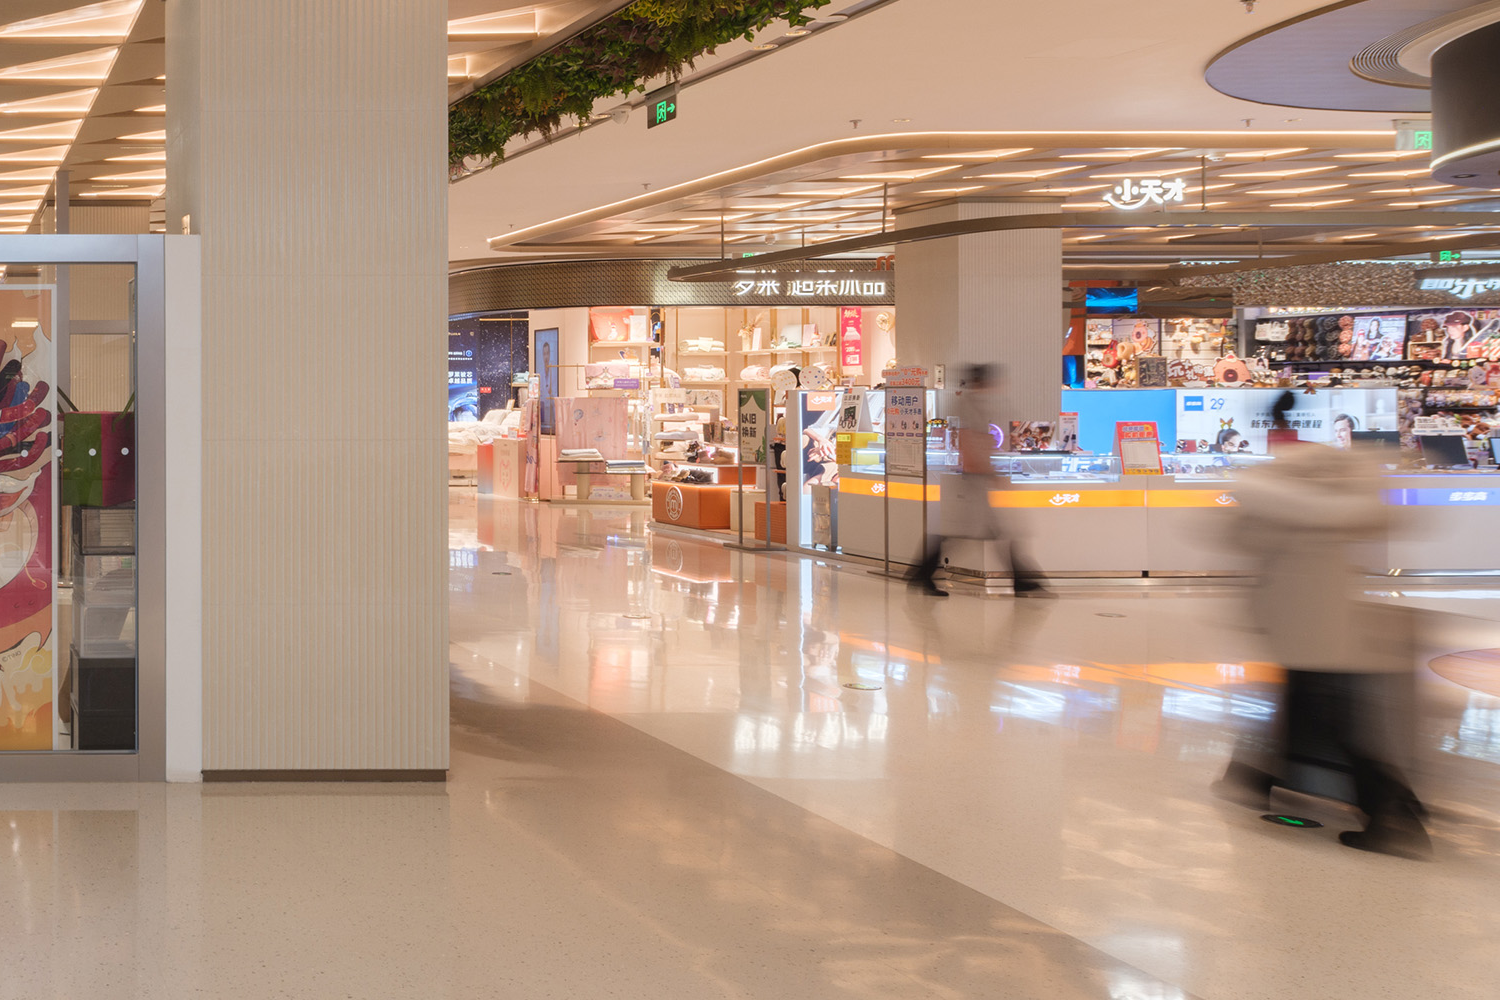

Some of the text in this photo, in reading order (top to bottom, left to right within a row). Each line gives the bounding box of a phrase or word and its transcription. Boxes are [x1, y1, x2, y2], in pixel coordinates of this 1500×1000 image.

[1102, 178, 1187, 210] 小天才
[891, 396, 919, 406] 移动用户
[1210, 398, 1226, 410] 29
[741, 413, 757, 425] 以旧
[741, 427, 757, 438] 换新
